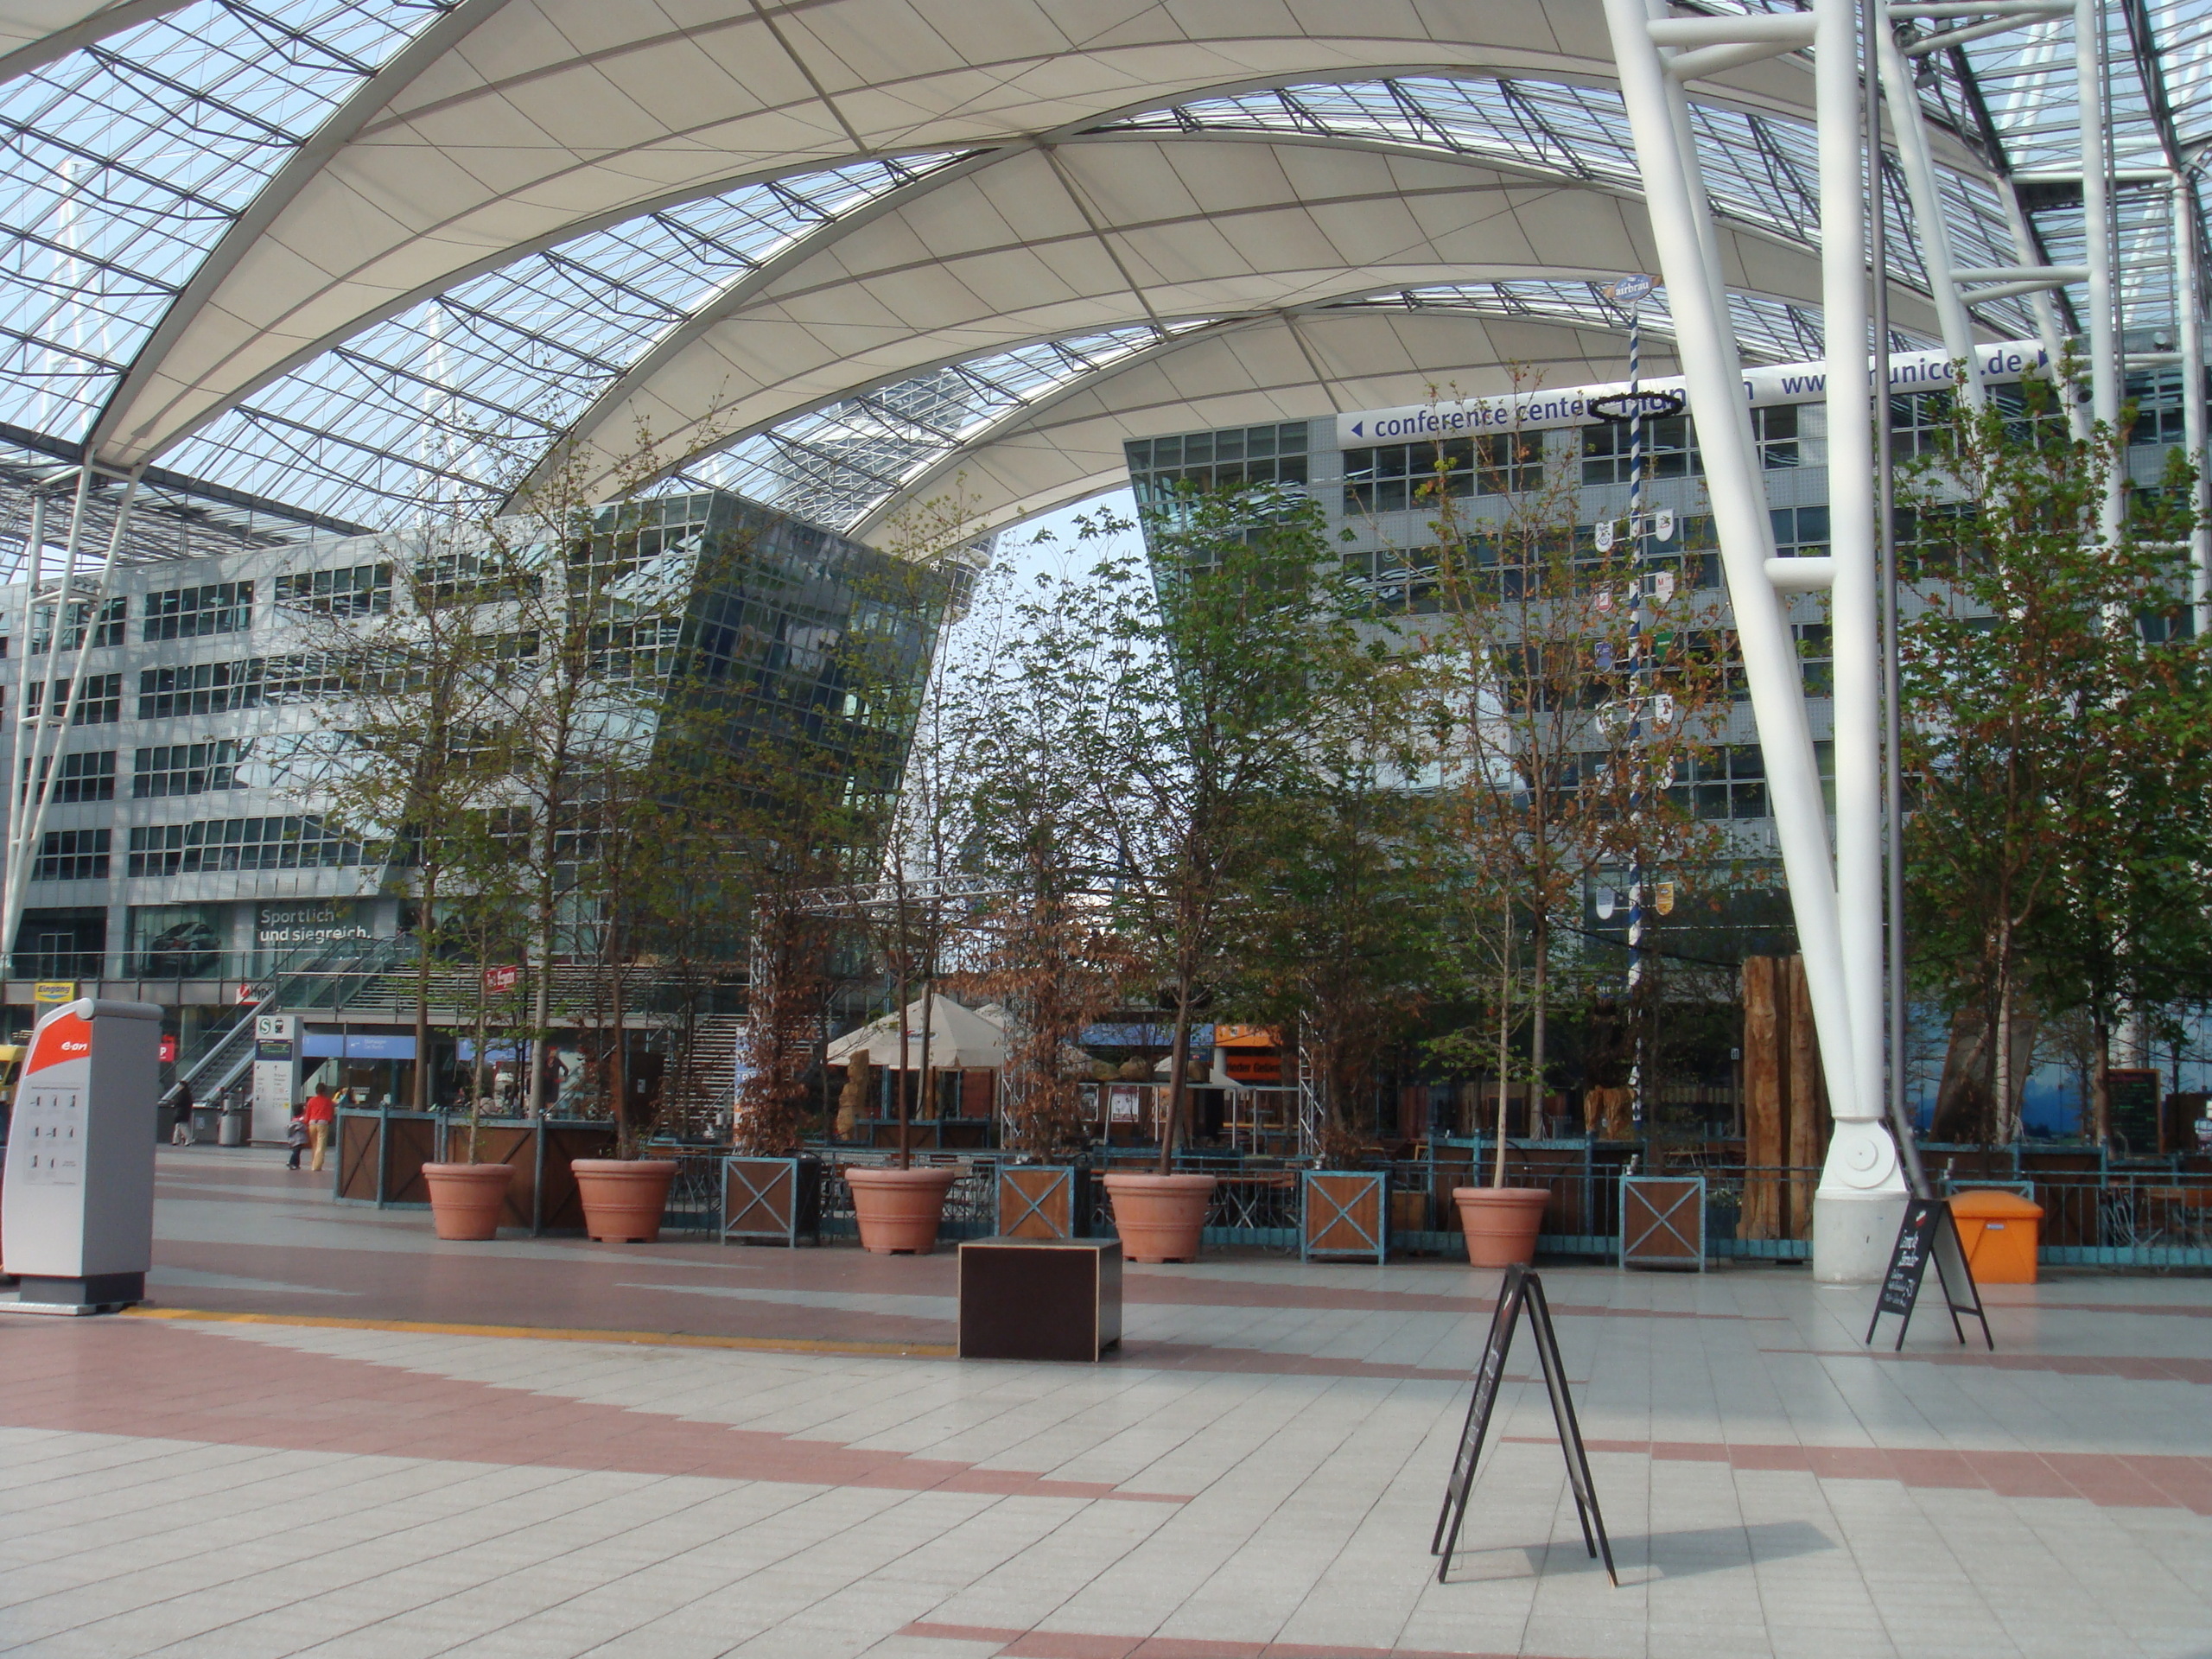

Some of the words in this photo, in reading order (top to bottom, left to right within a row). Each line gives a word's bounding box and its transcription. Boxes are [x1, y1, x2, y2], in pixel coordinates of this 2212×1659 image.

[1376, 405, 1508, 437] conference
[1516, 397, 1597, 423] center
[261, 908, 334, 927] Sportlich
[260, 927, 289, 942] und
[292, 925, 372, 944] siegreich.
[251, 985, 275, 1001] Hypo
[160, 1047, 167, 1056] P
